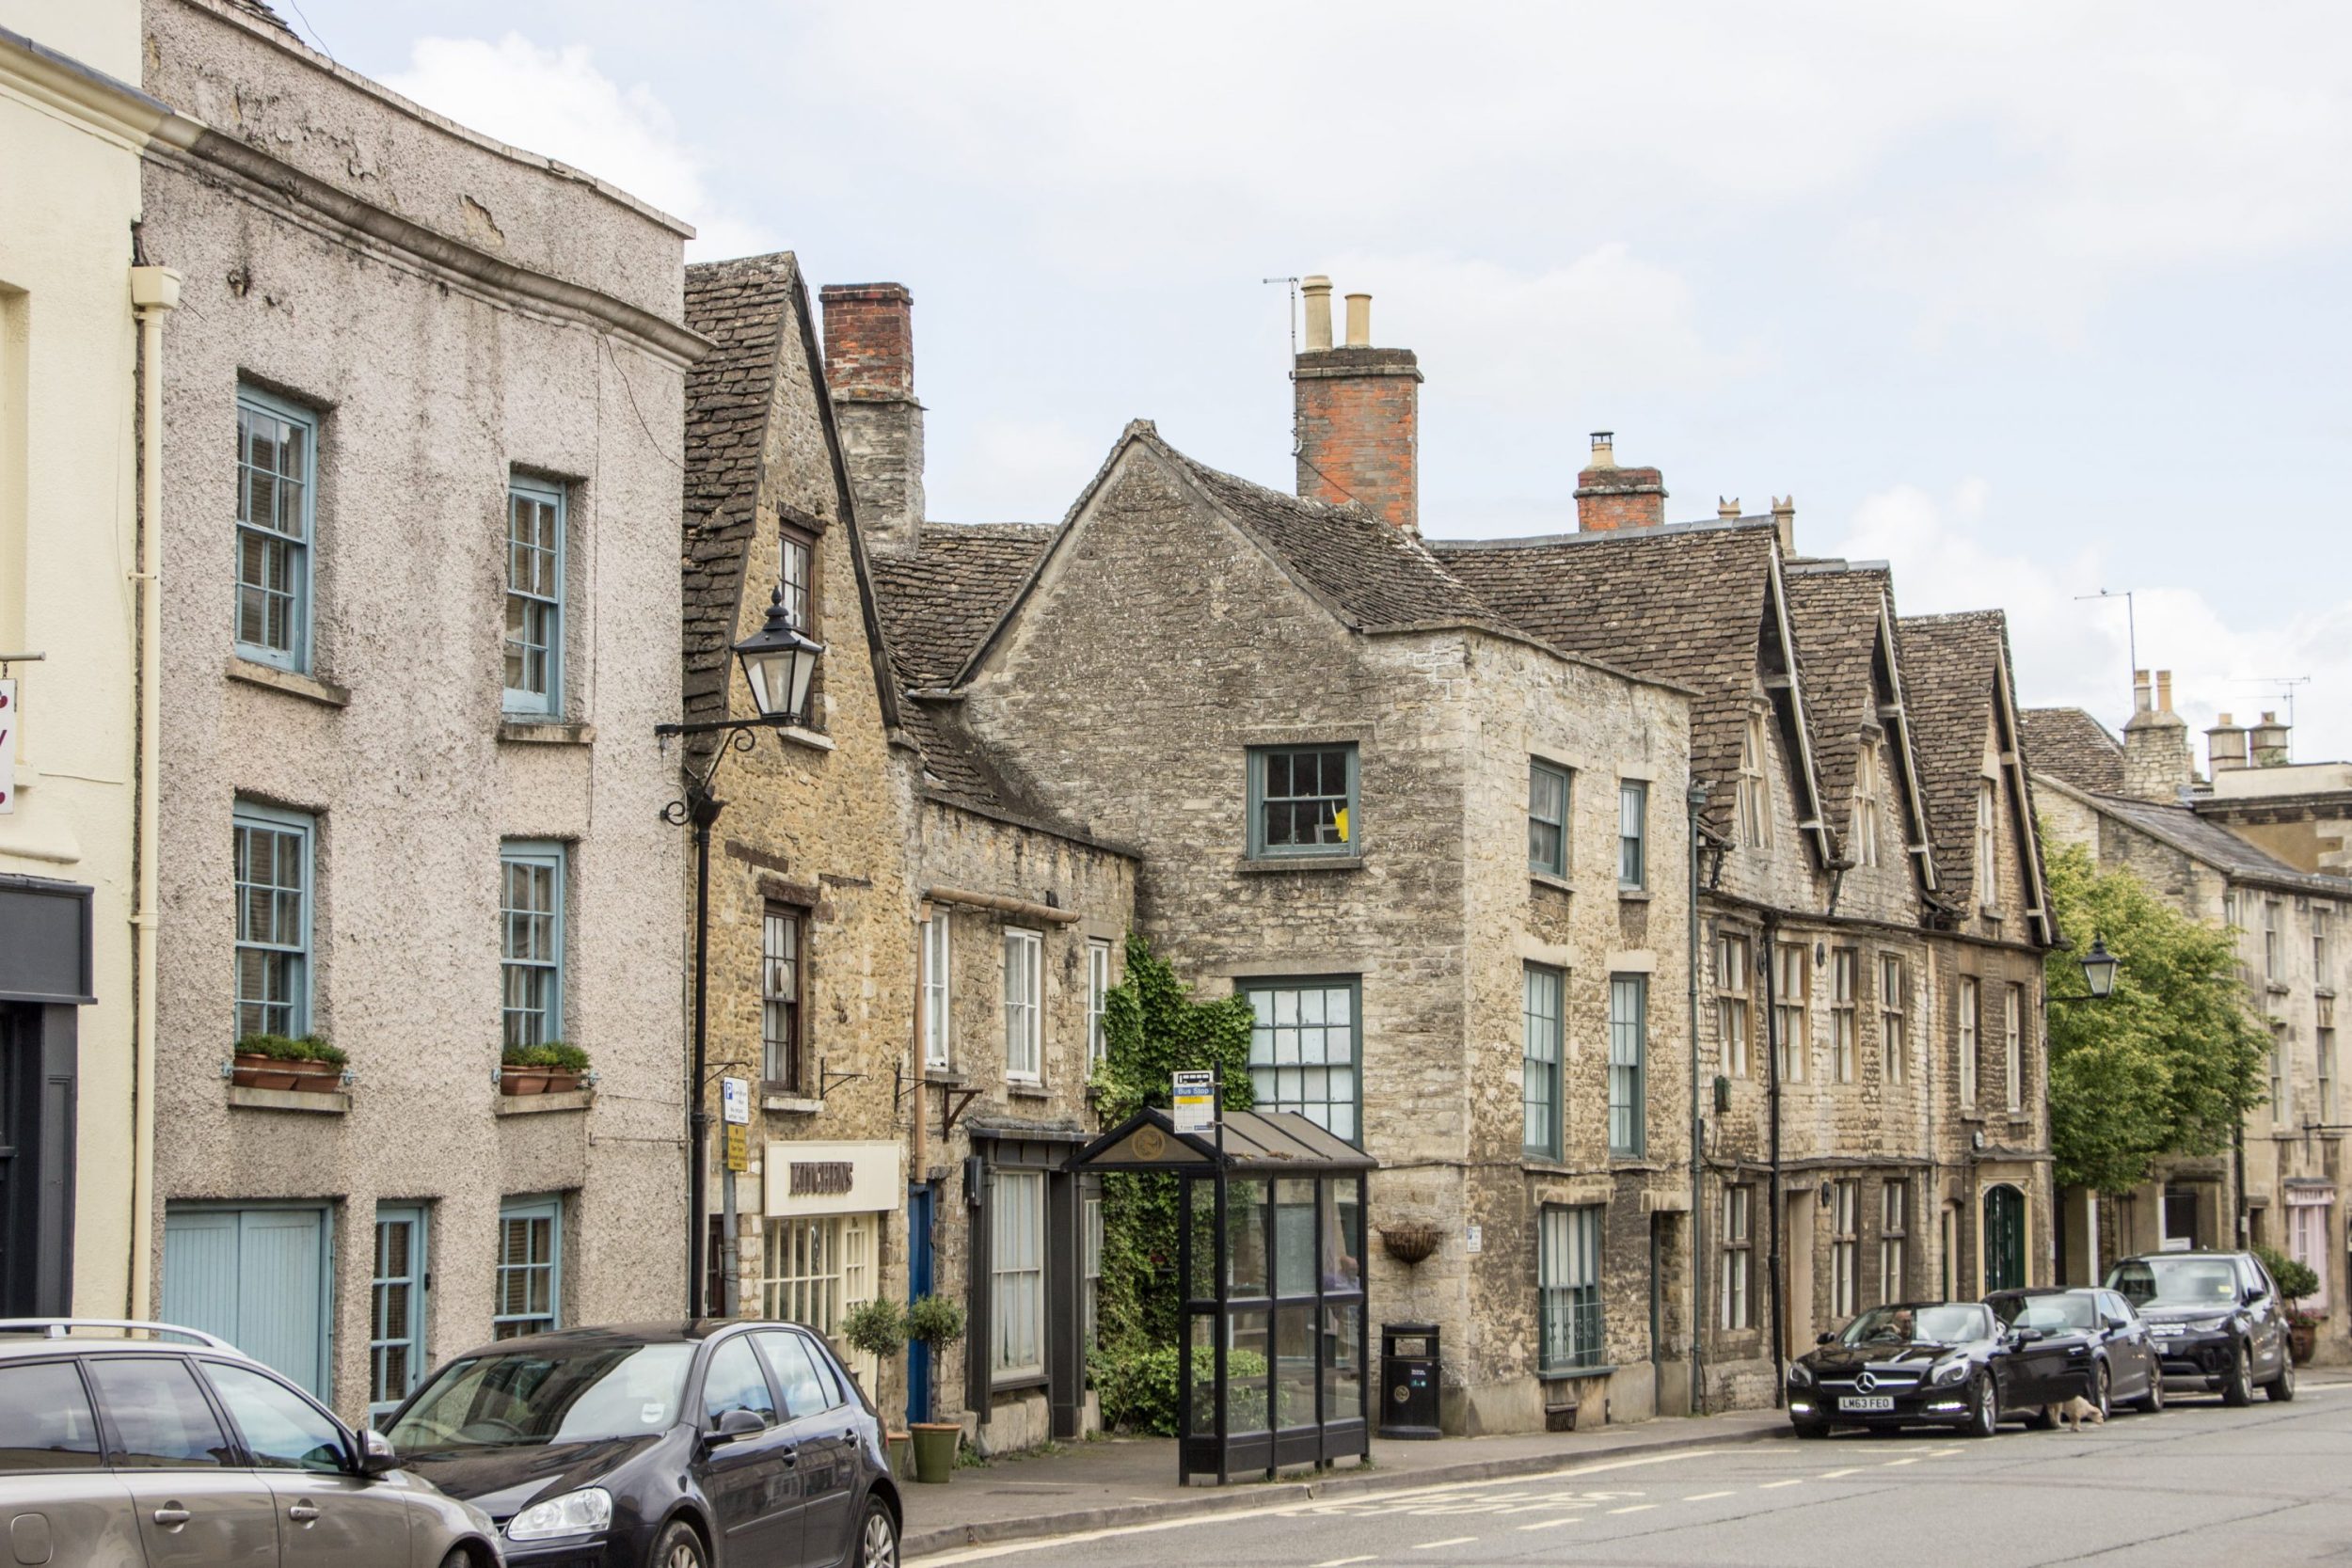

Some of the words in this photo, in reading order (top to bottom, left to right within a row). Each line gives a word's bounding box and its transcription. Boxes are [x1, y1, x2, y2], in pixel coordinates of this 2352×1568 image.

[789, 1162, 853, 1196] KITCHENS
[1843, 1399, 1867, 1408] LM63
[1382, 1492, 1645, 1504] BUS
[1276, 1502, 1597, 1516] STOP
